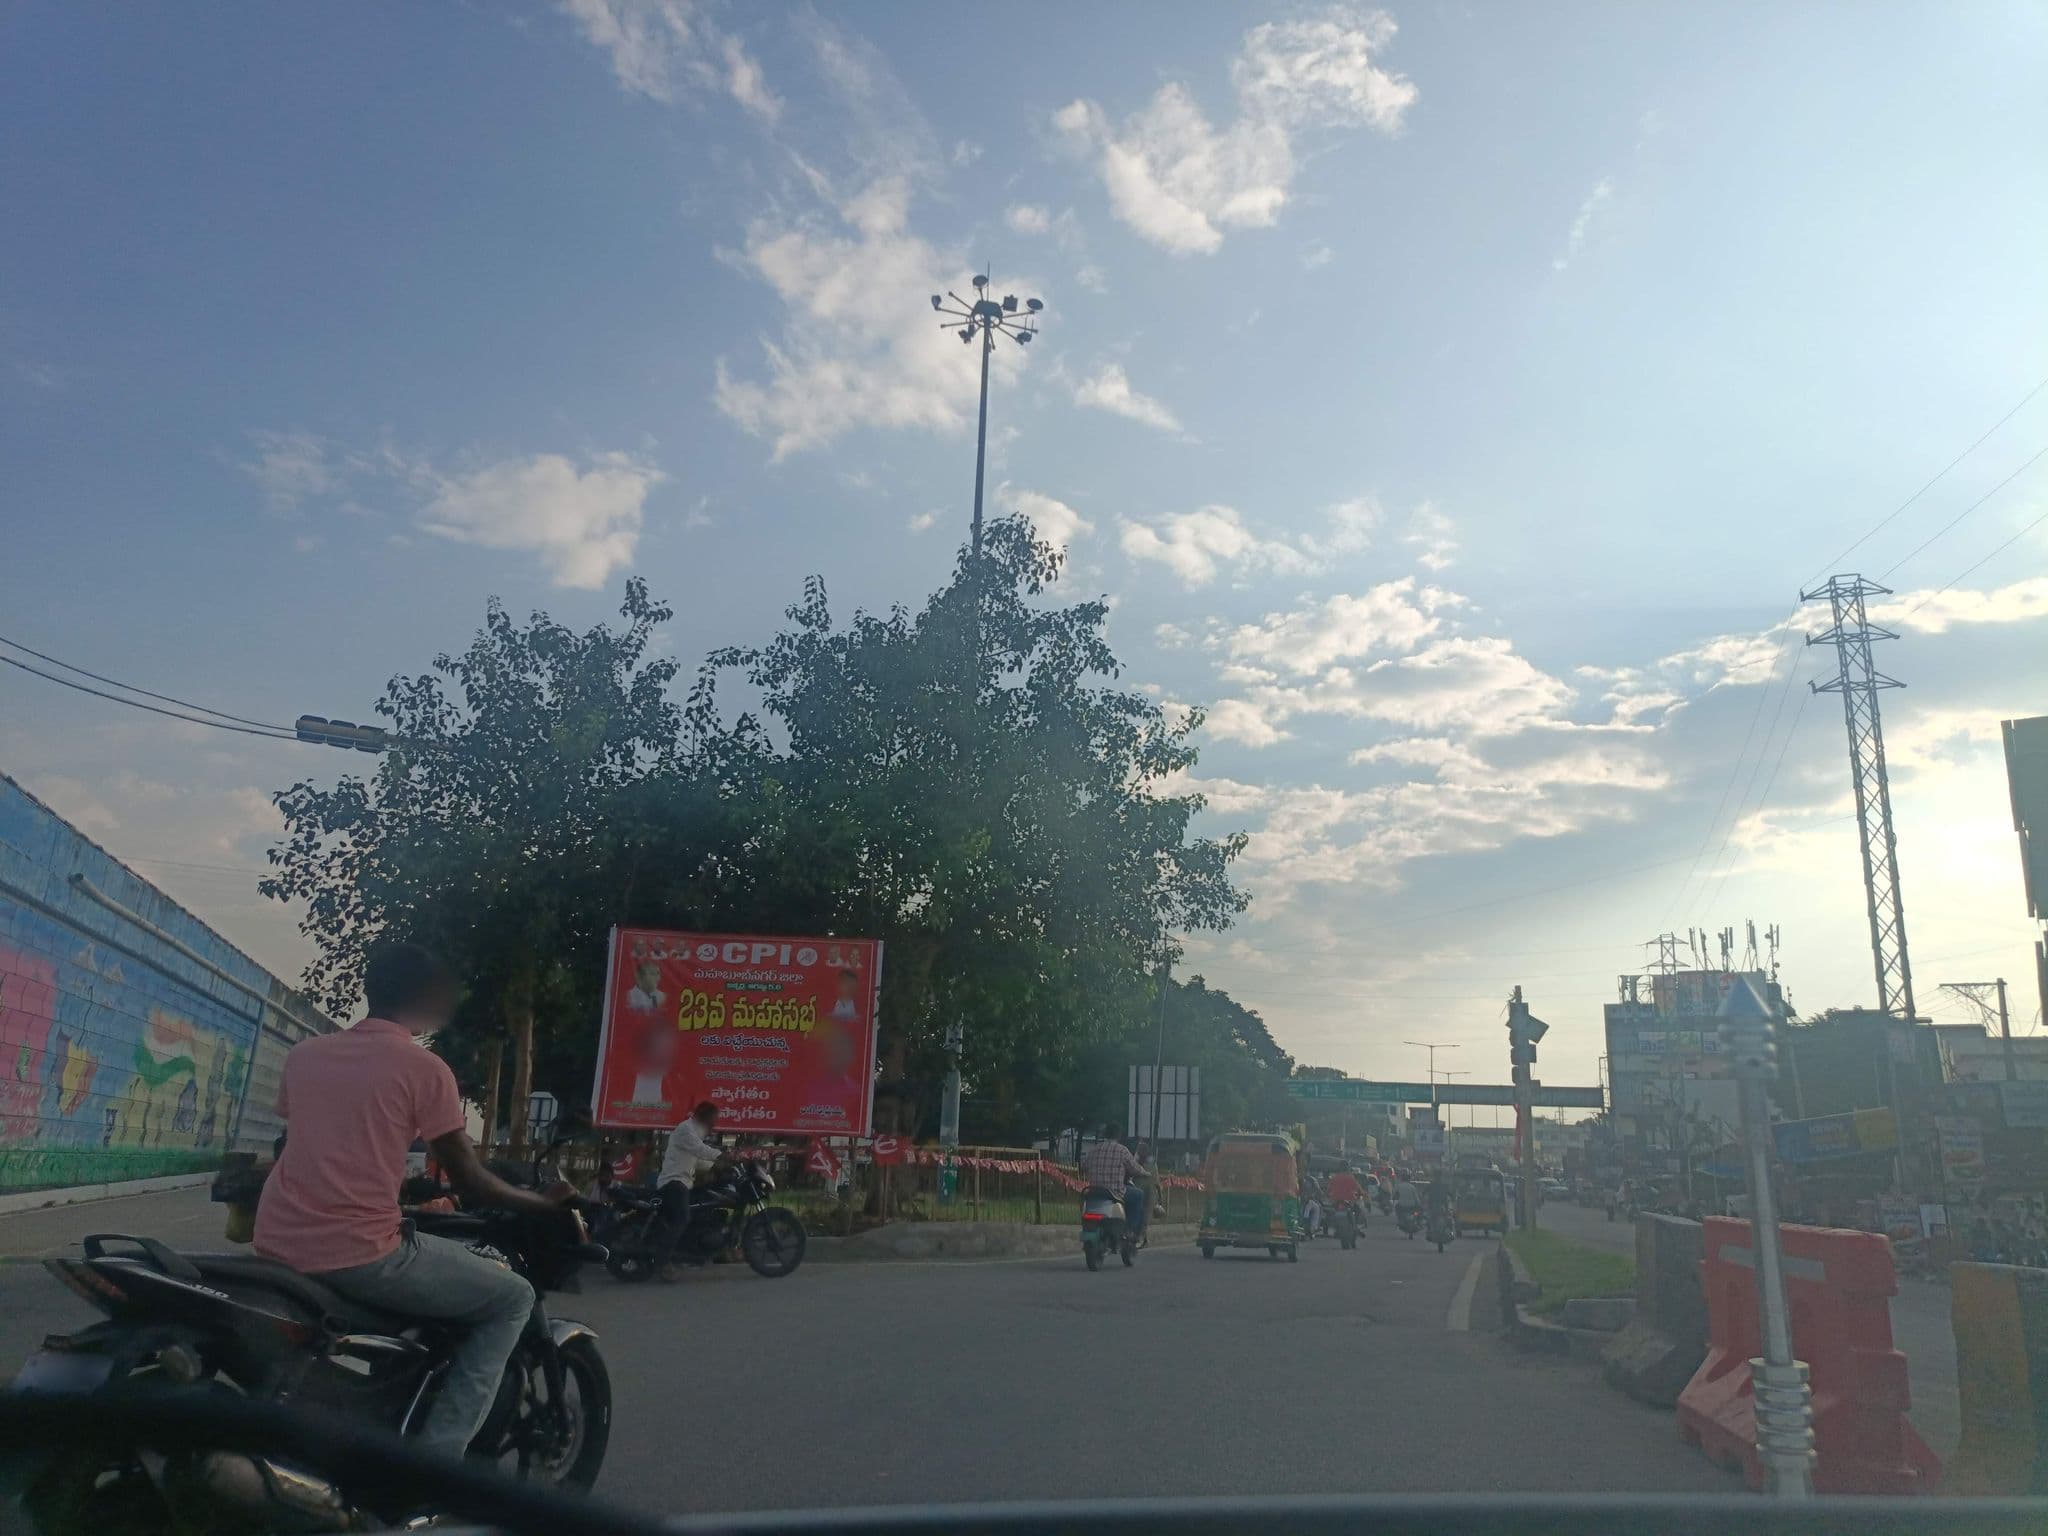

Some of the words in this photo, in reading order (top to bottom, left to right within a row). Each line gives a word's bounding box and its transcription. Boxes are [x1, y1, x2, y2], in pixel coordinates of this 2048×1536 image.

[722, 942, 791, 966] CPI
[678, 988, 725, 1030] 23వ
[711, 1086, 770, 1102] స్వాగతం
